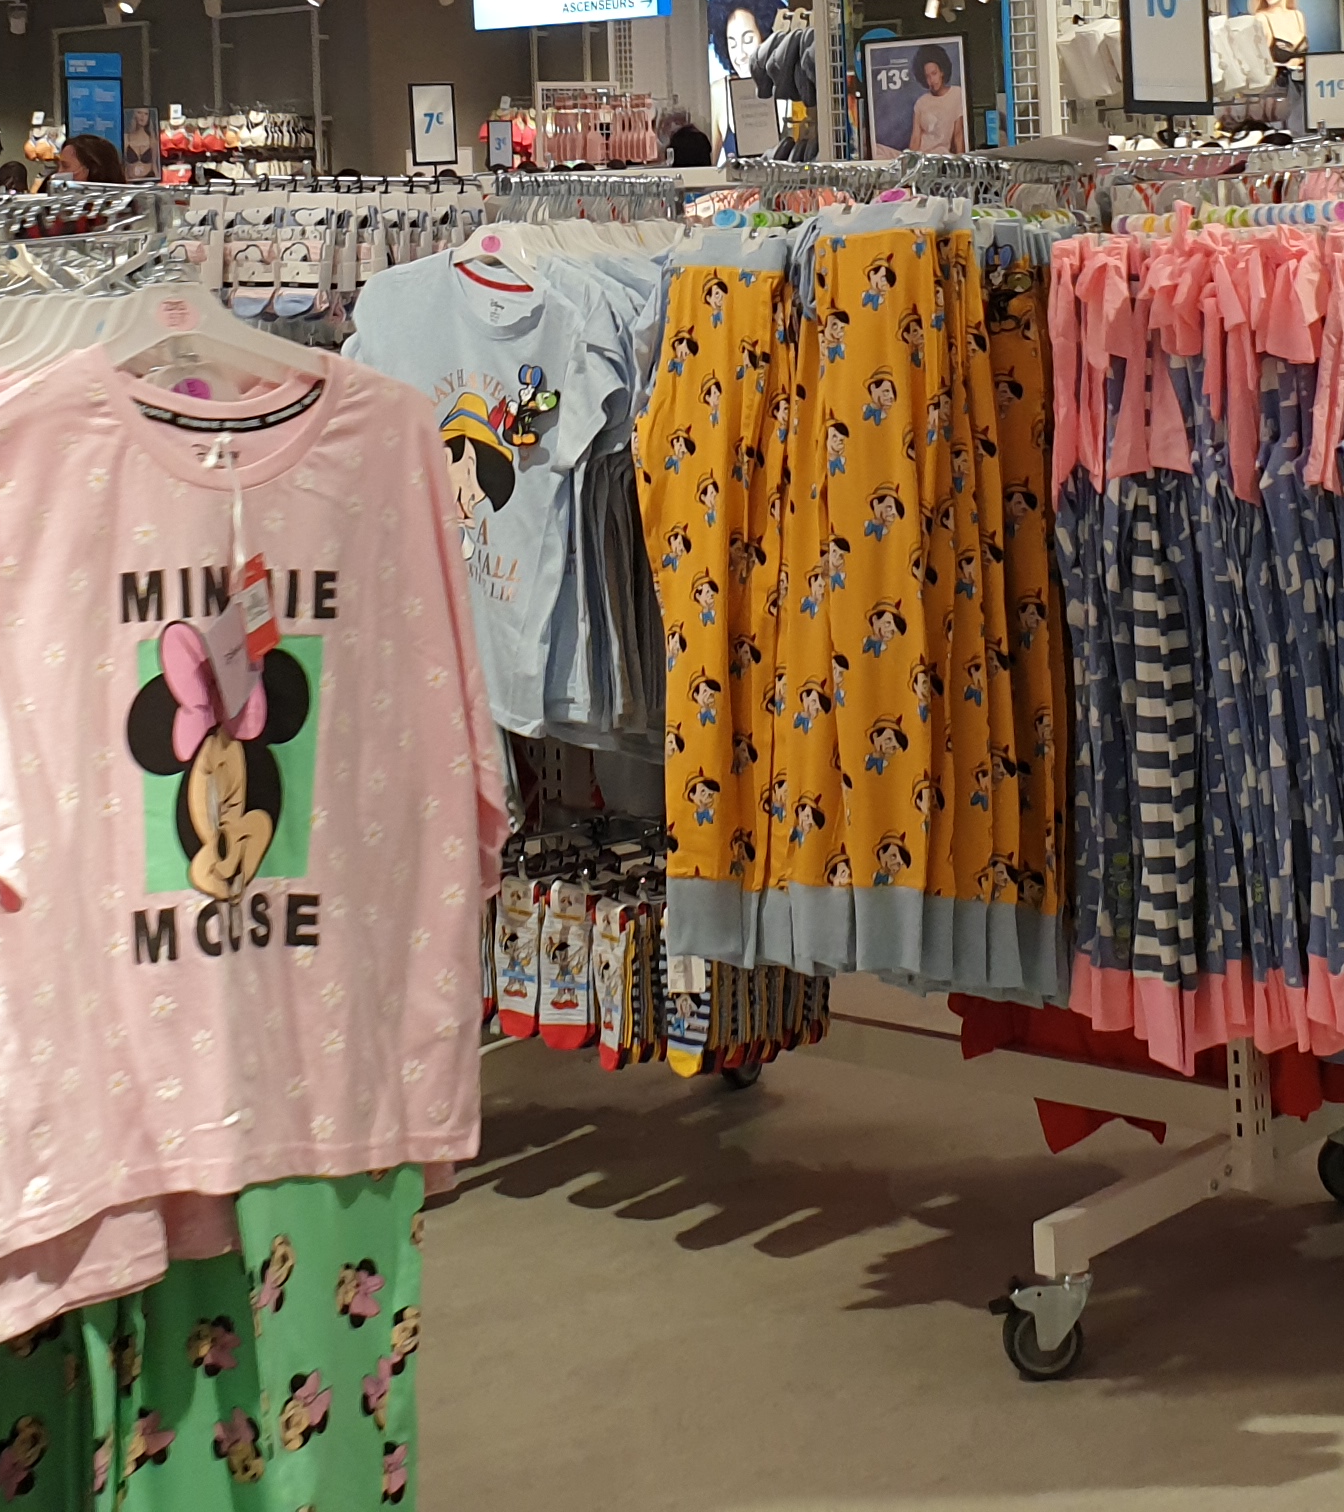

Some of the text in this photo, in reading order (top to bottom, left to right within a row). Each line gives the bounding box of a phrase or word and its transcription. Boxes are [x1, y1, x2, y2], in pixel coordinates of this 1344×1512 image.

[876, 68, 910, 90] 13€
[1315, 79, 1344, 98] 11€
[423, 111, 444, 134] 7€
[476, 517, 488, 545] A
[121, 565, 339, 623] MINIE
